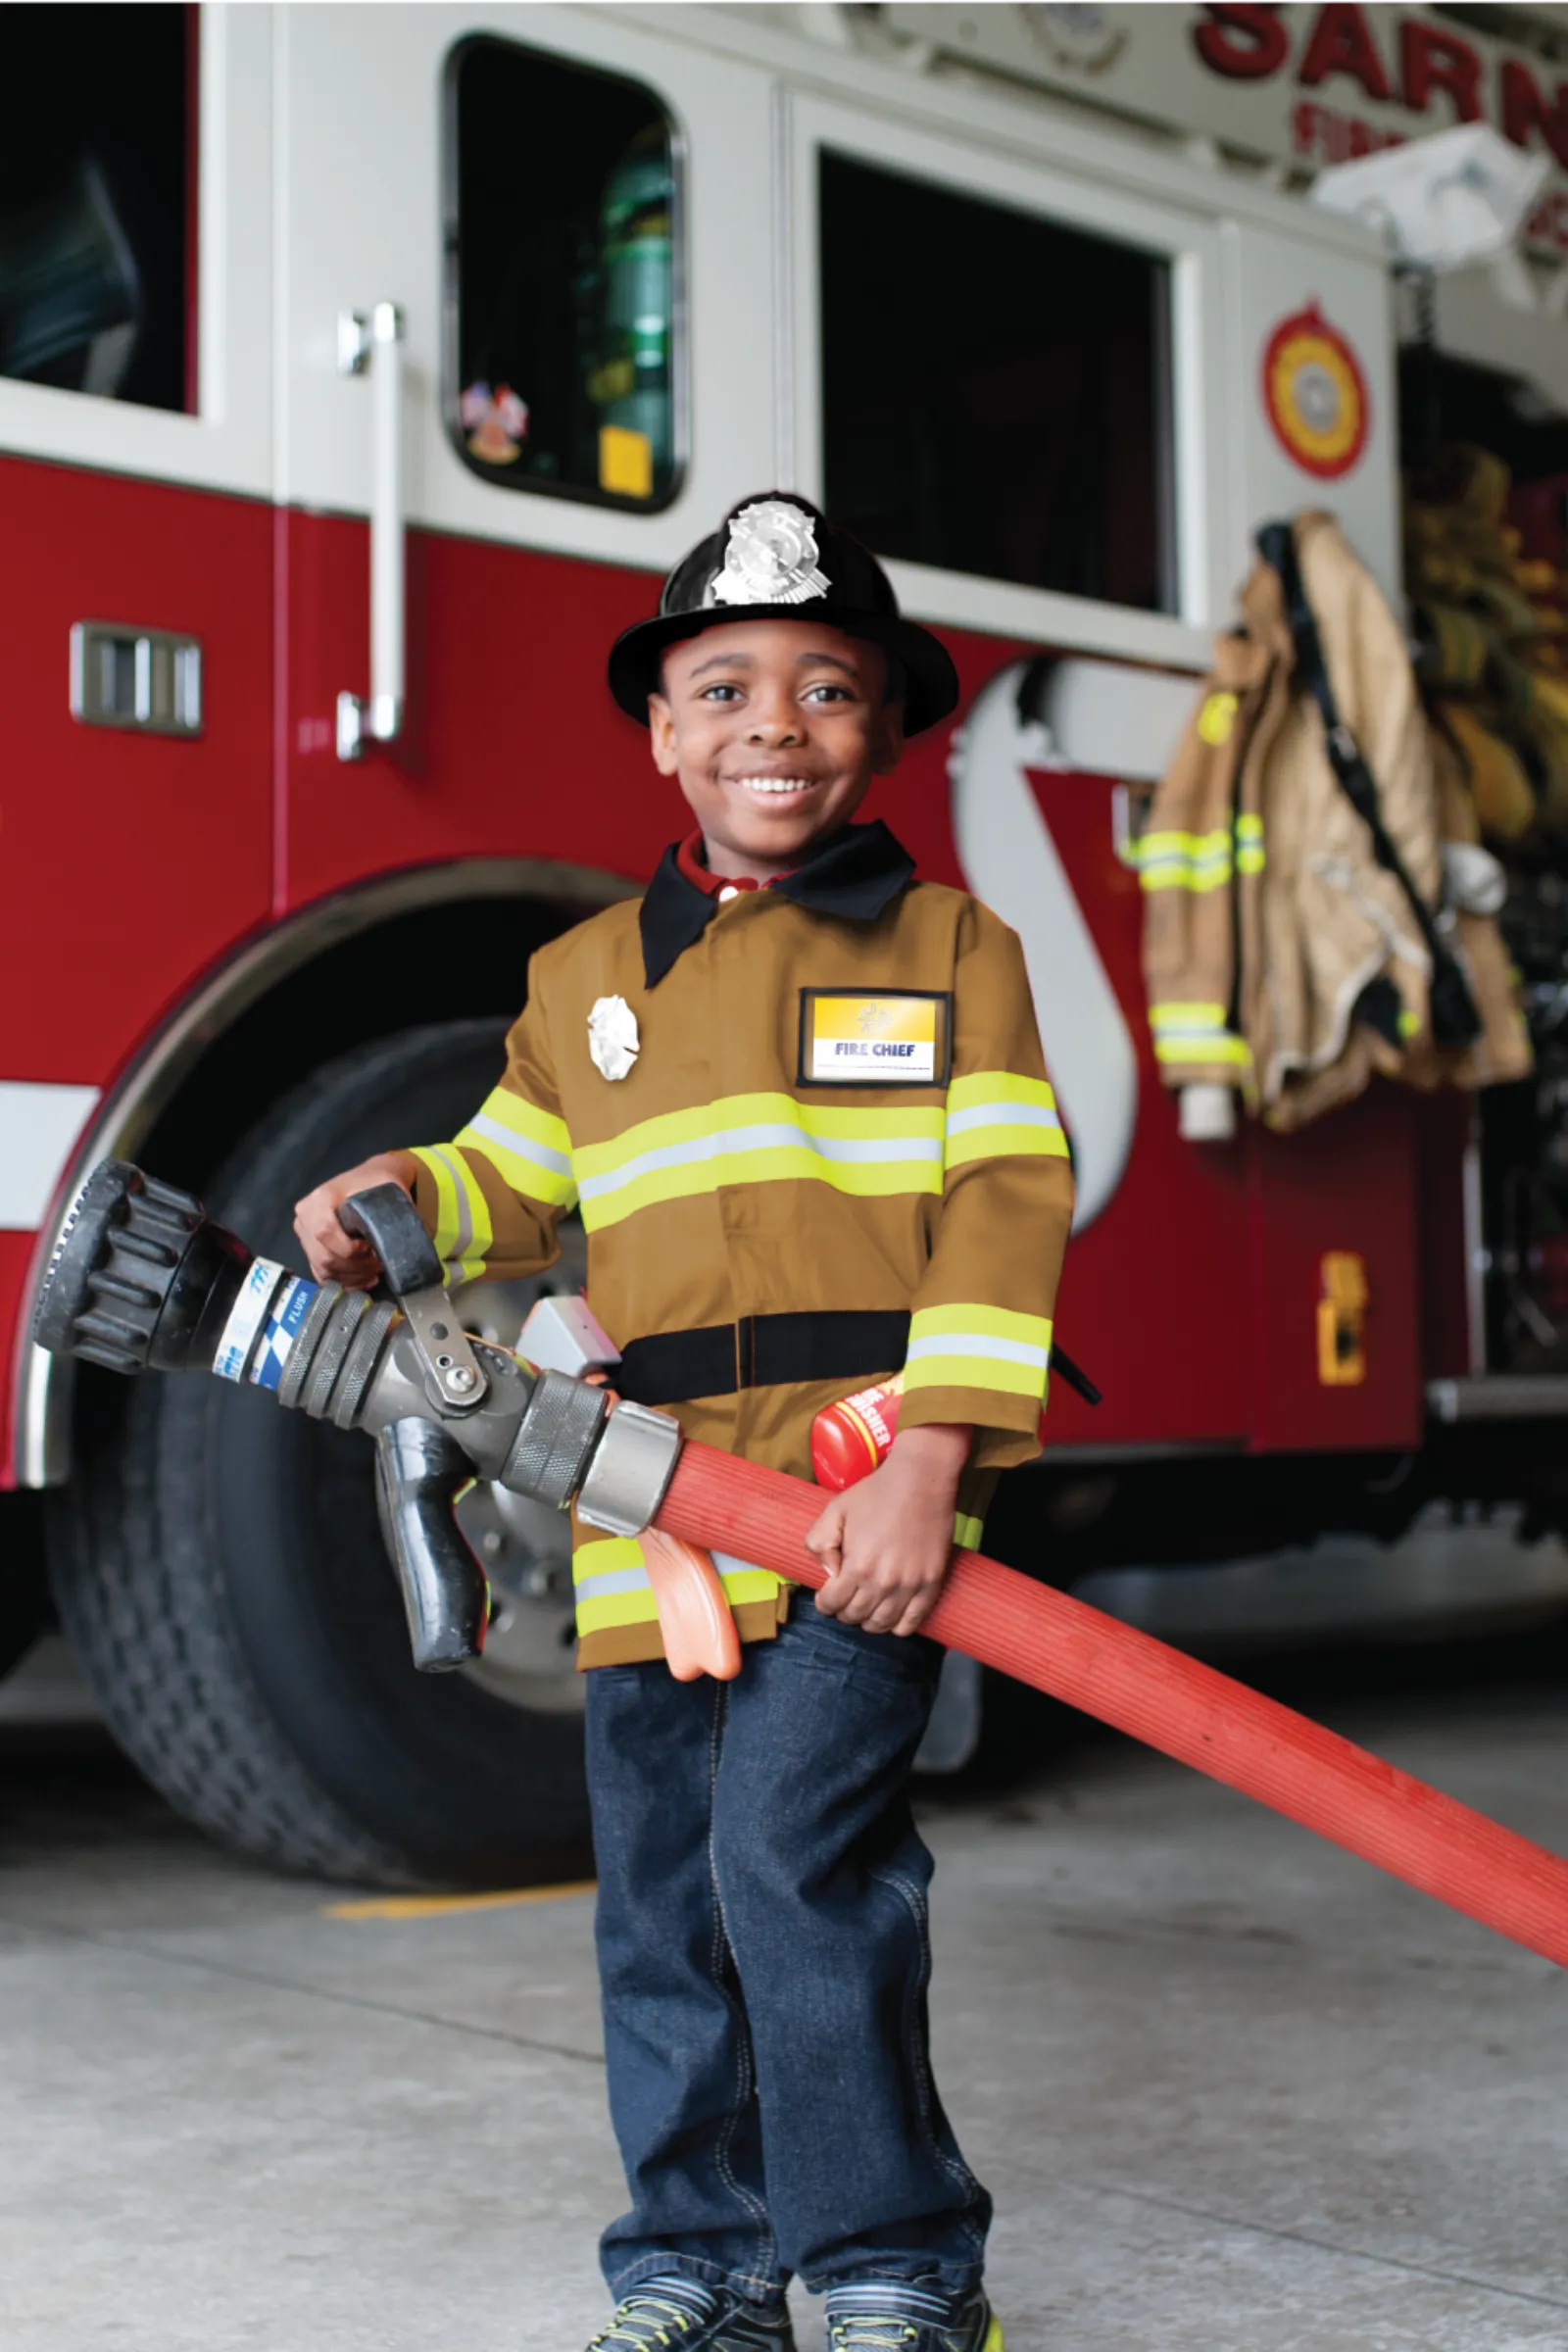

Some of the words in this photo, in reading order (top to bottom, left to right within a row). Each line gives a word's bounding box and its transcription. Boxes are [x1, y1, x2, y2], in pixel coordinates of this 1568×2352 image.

[836, 1043, 868, 1055] FIRE
[872, 1044, 915, 1056] CHIEF
[288, 1291, 309, 1325] FLUSH
